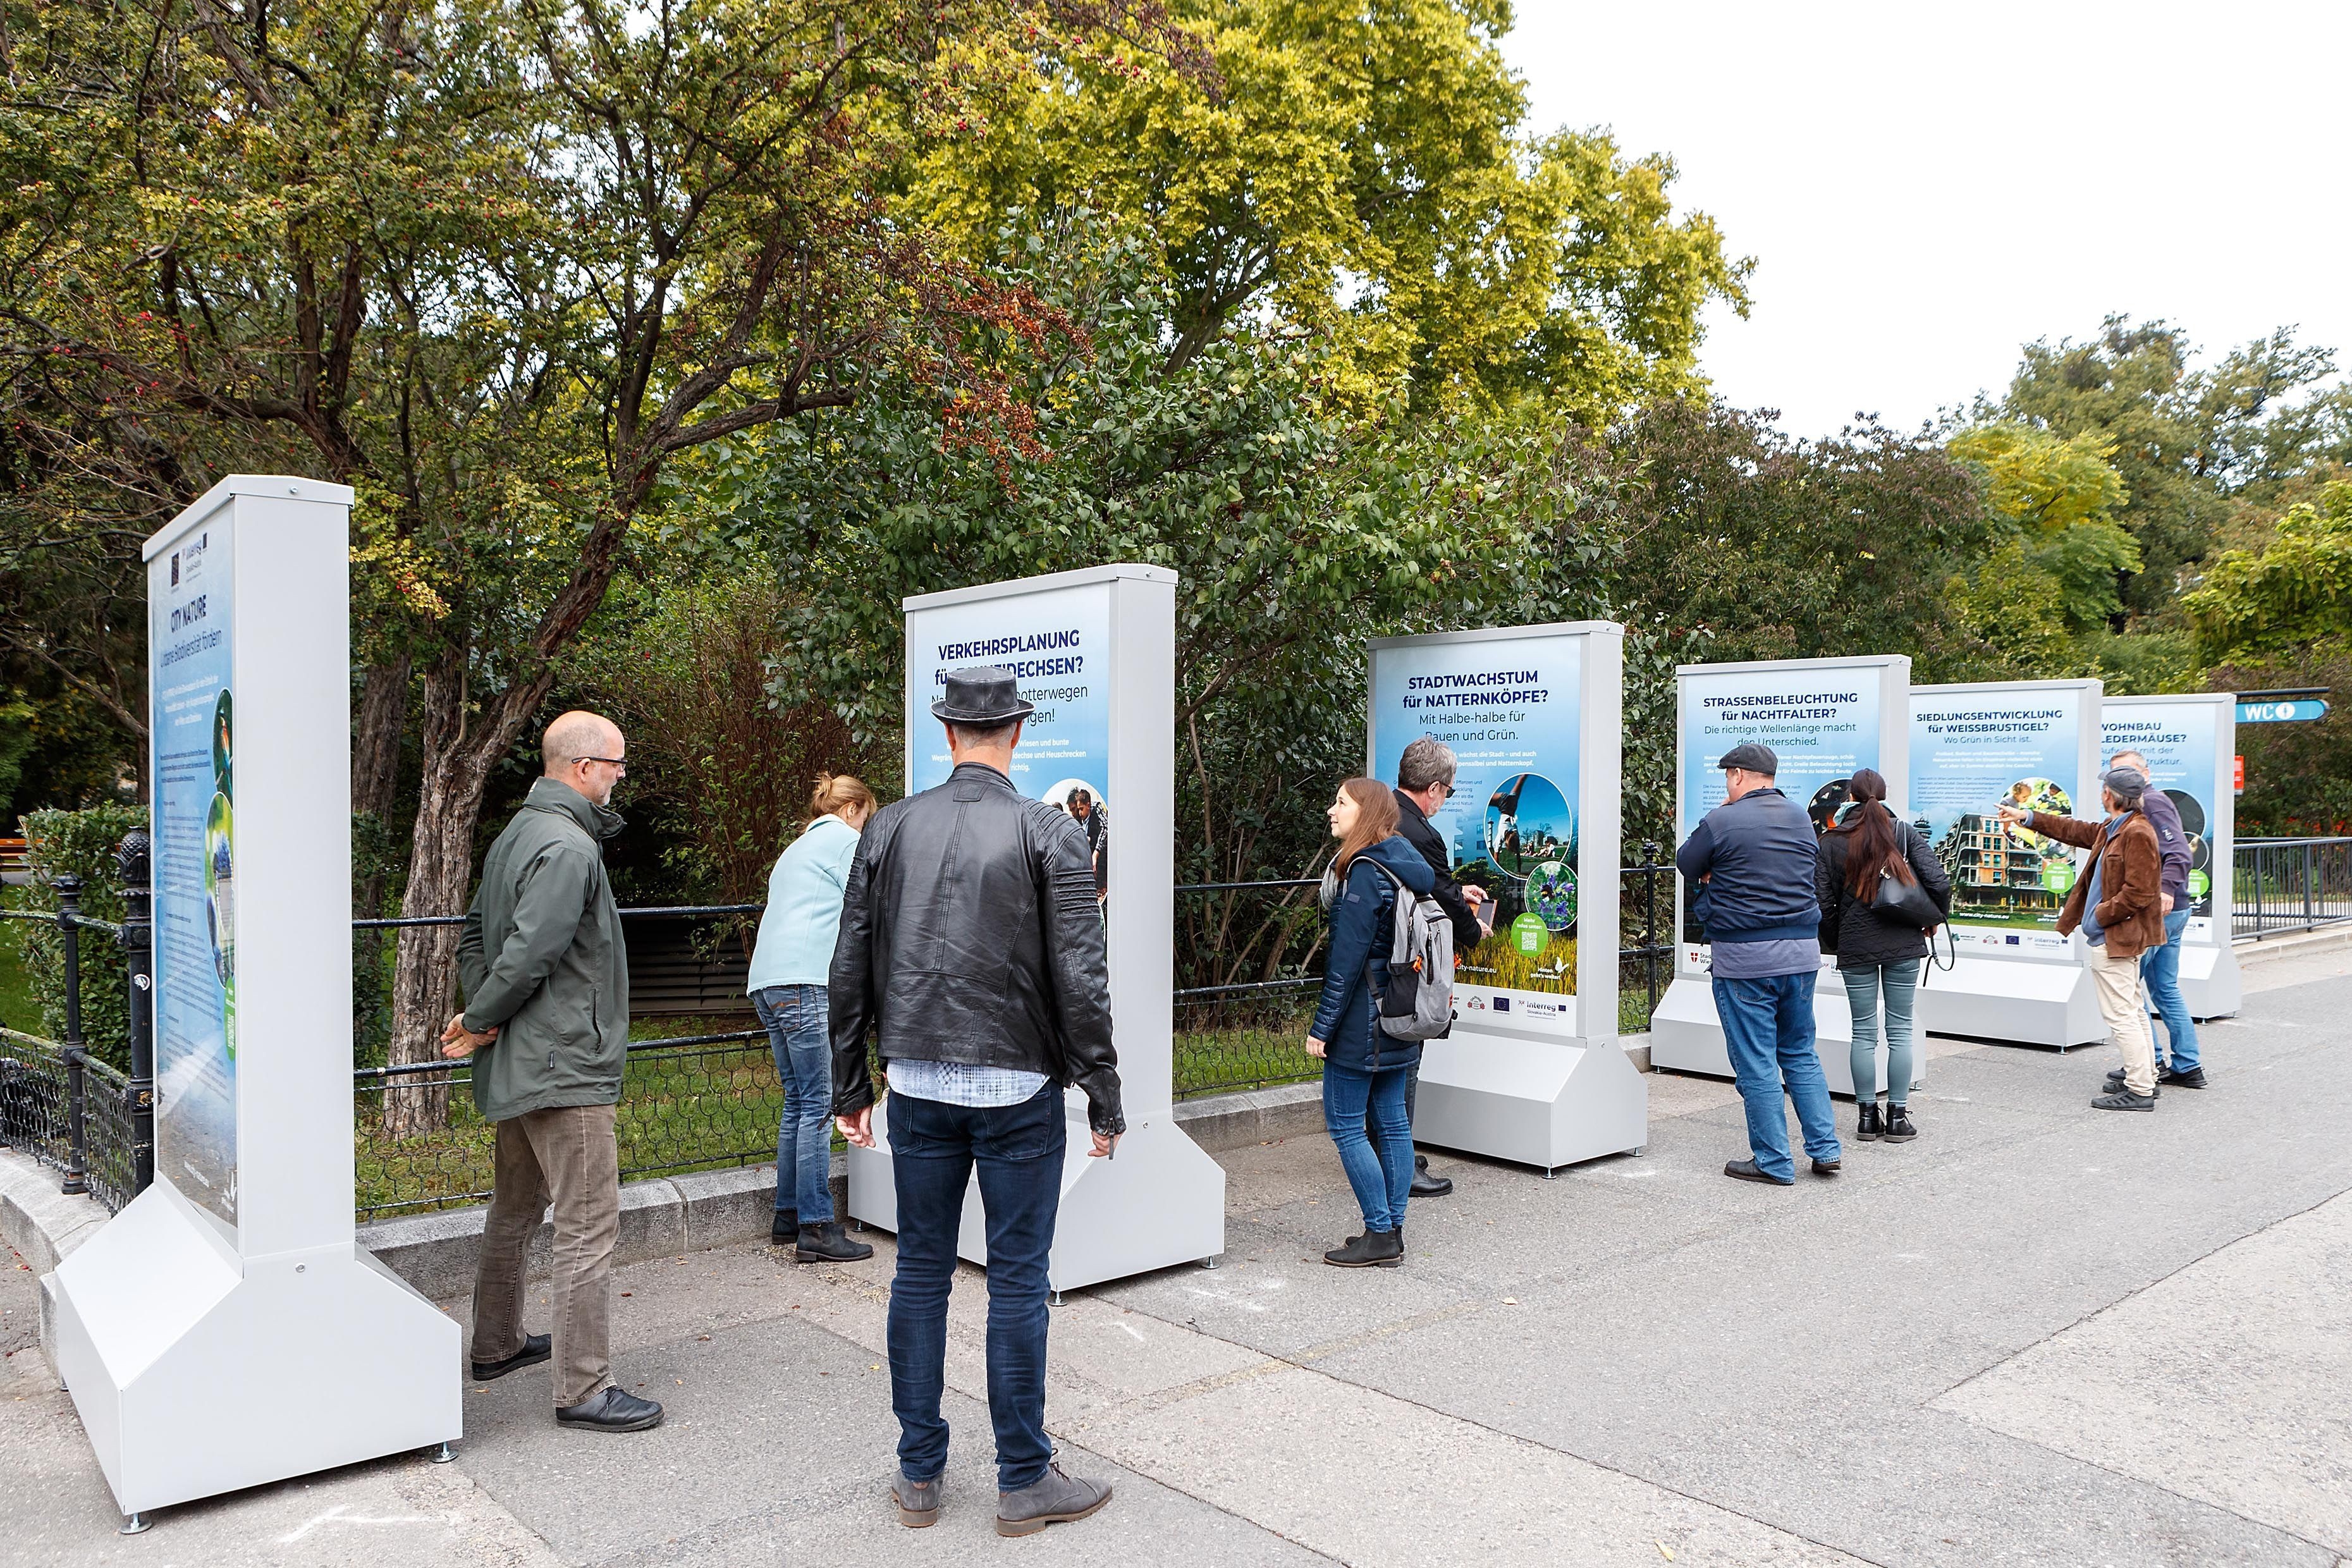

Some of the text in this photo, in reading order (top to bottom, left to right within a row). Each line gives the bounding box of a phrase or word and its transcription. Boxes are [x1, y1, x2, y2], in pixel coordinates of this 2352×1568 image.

[171, 594, 207, 633] CITY NATURE
[938, 629, 1080, 660] VERKEHRSPLANUNG
[935, 656, 1084, 685] fü DECHSEN?
[1409, 670, 1538, 690] STADTWACHSTUM
[1403, 689, 1548, 709] für NATTERNKÖPFE?
[1703, 692, 1858, 707] STRASSENBELEUCHTUNG
[1419, 710, 1526, 725] Mit Halbe-halbe für
[1722, 708, 1837, 721] für NACHTFALTER?
[1916, 709, 2062, 722] SIEDLUNGSENTWICKLUNG
[2245, 703, 2274, 720] WC
[1705, 723, 1856, 735] Die richtige Wellenlänge macht
[1928, 723, 2049, 733] für WEISSBRUSTIGEL?
[1462, 730, 1485, 741] und
[1488, 729, 1519, 740] Grün.
[1944, 735, 2032, 744] Wo Grün in Sicht ist.
[2102, 732, 2187, 743] EDERMÄUSE?
[1040, 738, 1051, 747] und
[1052, 738, 1069, 746] bunte
[1758, 737, 1819, 746] Unterschied.
[1034, 750, 1045, 759] und
[1046, 750, 1086, 758] Heuschrecken
[2139, 746, 2155, 754] mit
[2157, 746, 2174, 754] der
[1011, 763, 1030, 772] richtig.
